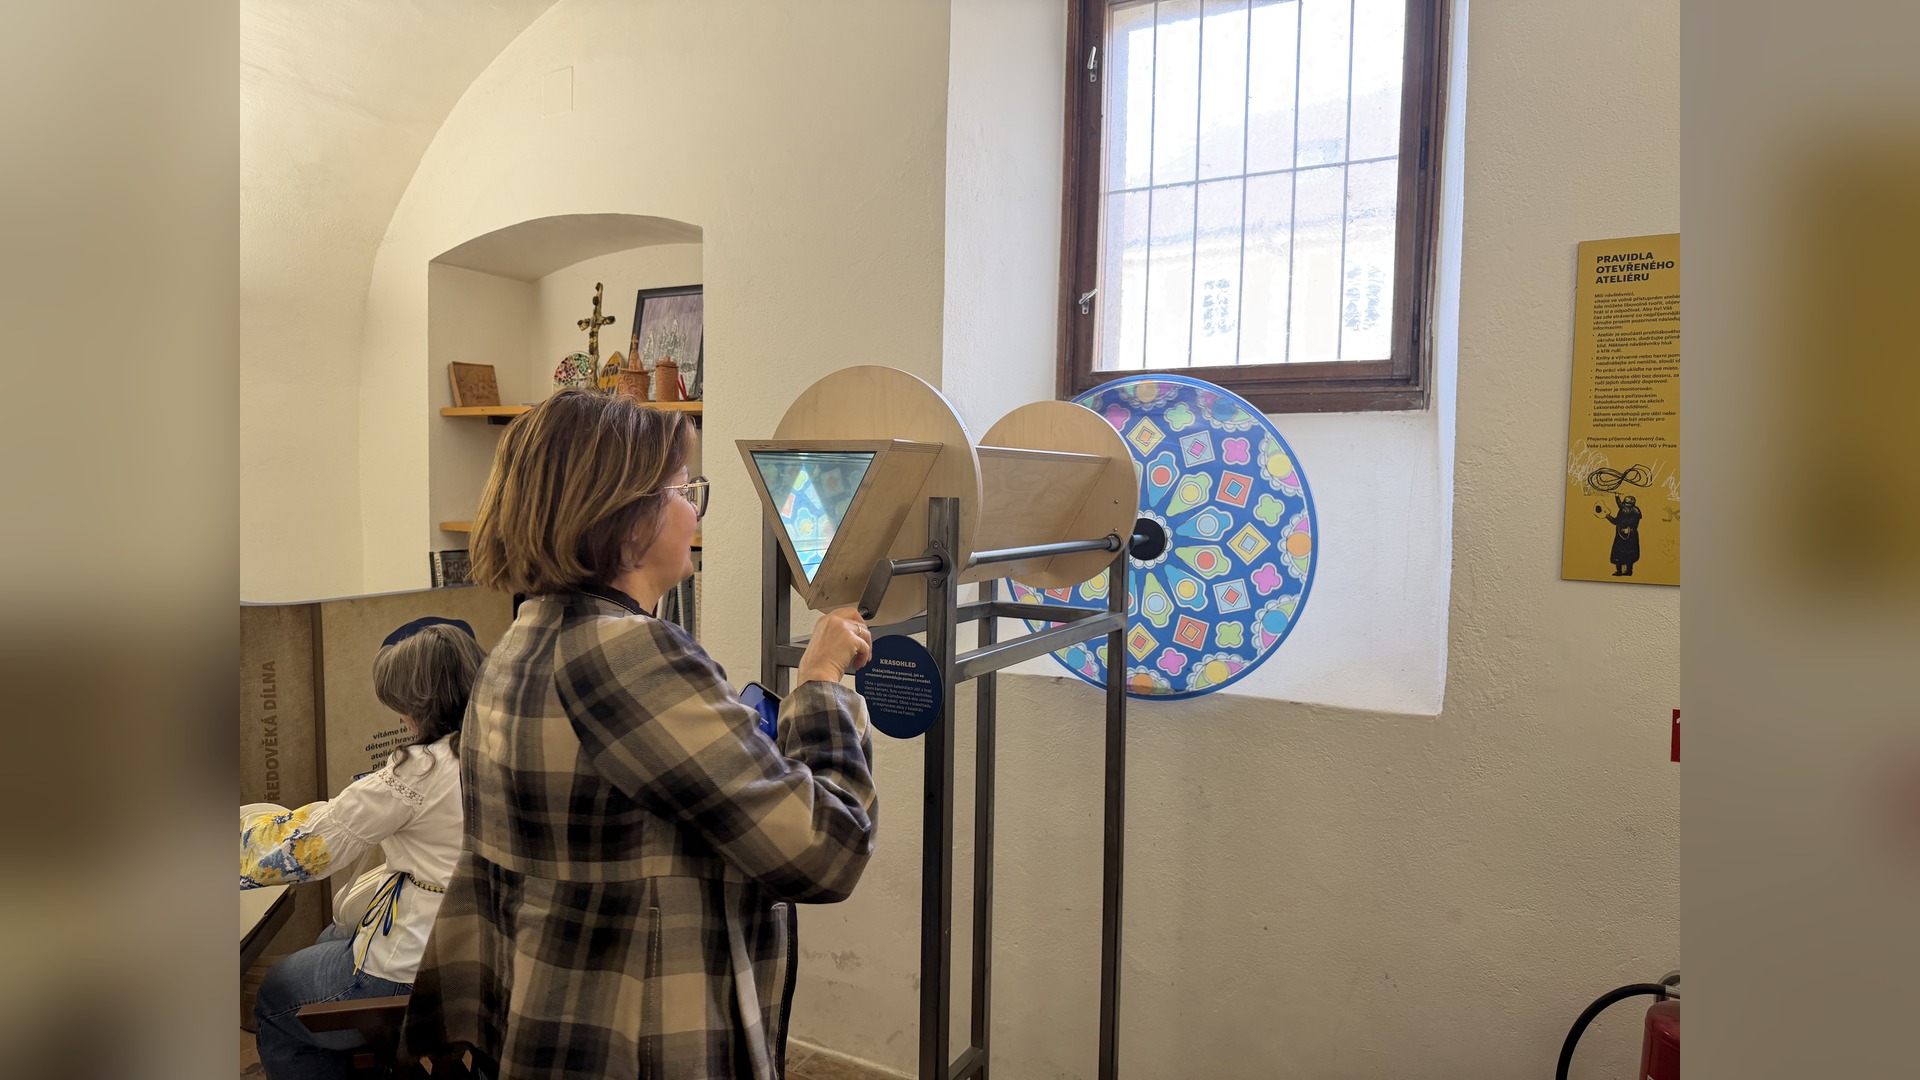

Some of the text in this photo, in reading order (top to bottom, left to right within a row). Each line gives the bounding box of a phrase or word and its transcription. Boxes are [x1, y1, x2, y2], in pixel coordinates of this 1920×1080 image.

[1597, 252, 1653, 263] PRAVIDLA
[1596, 261, 1674, 273] OTEVŘENÉHO
[1596, 273, 1649, 284] ATELIÉRU
[880, 659, 916, 668] KRASOHLED
[260, 660, 277, 710] DÍLNA
[373, 728, 399, 740] vítáme
[365, 742, 390, 751] dětem
